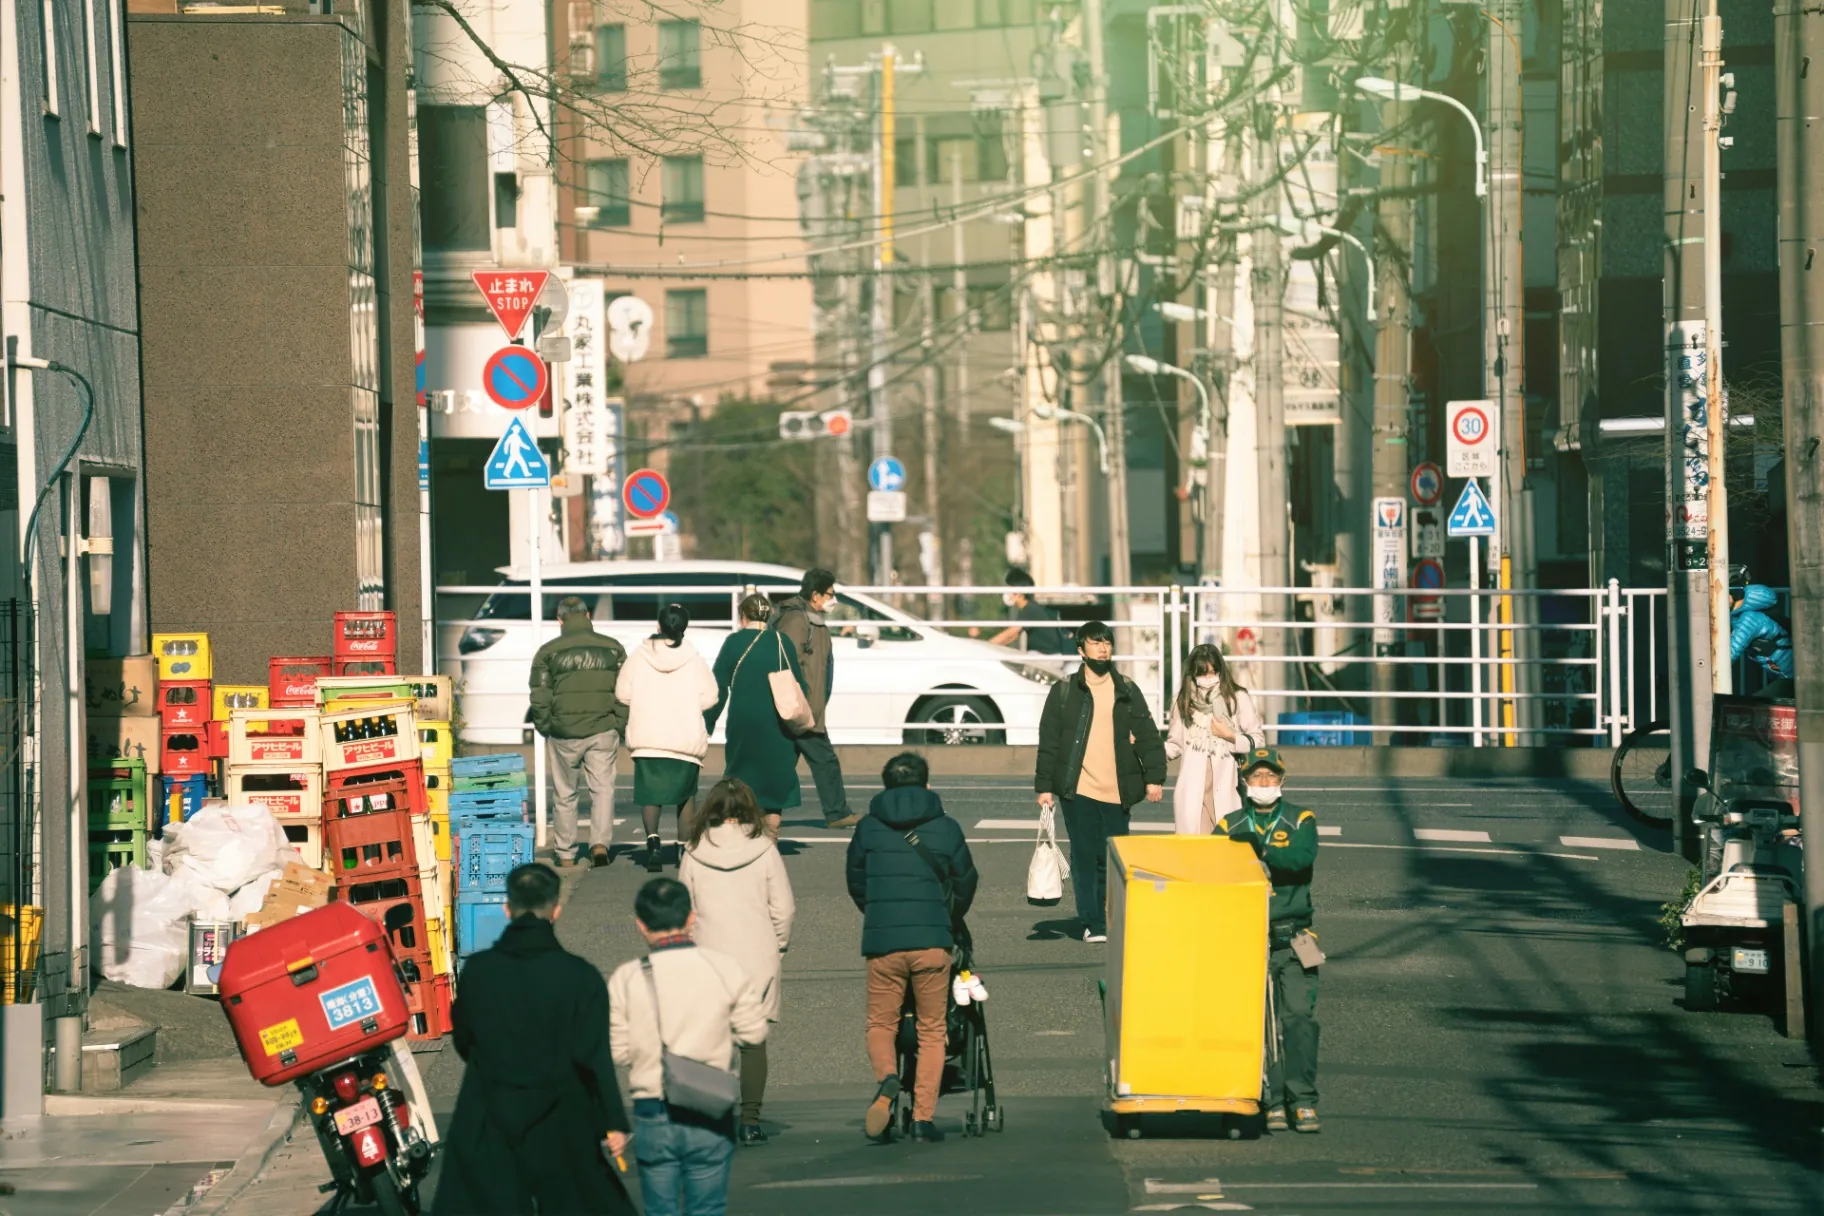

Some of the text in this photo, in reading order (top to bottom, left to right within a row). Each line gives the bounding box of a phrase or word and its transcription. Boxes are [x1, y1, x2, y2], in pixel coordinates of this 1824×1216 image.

[489, 277, 535, 294] 止まれ
[497, 297, 529, 310] STOP
[1461, 417, 1482, 435] 30
[1455, 462, 1488, 472] ここから
[1685, 557, 1709, 567] 6-2
[252, 741, 302, 753] アサヒビール
[343, 739, 395, 756] アサヒビール
[249, 796, 300, 806] アサヒビール
[332, 996, 374, 1023] 3813
[347, 1108, 379, 1128] 38-13
[361, 1133, 380, 1160] 4
